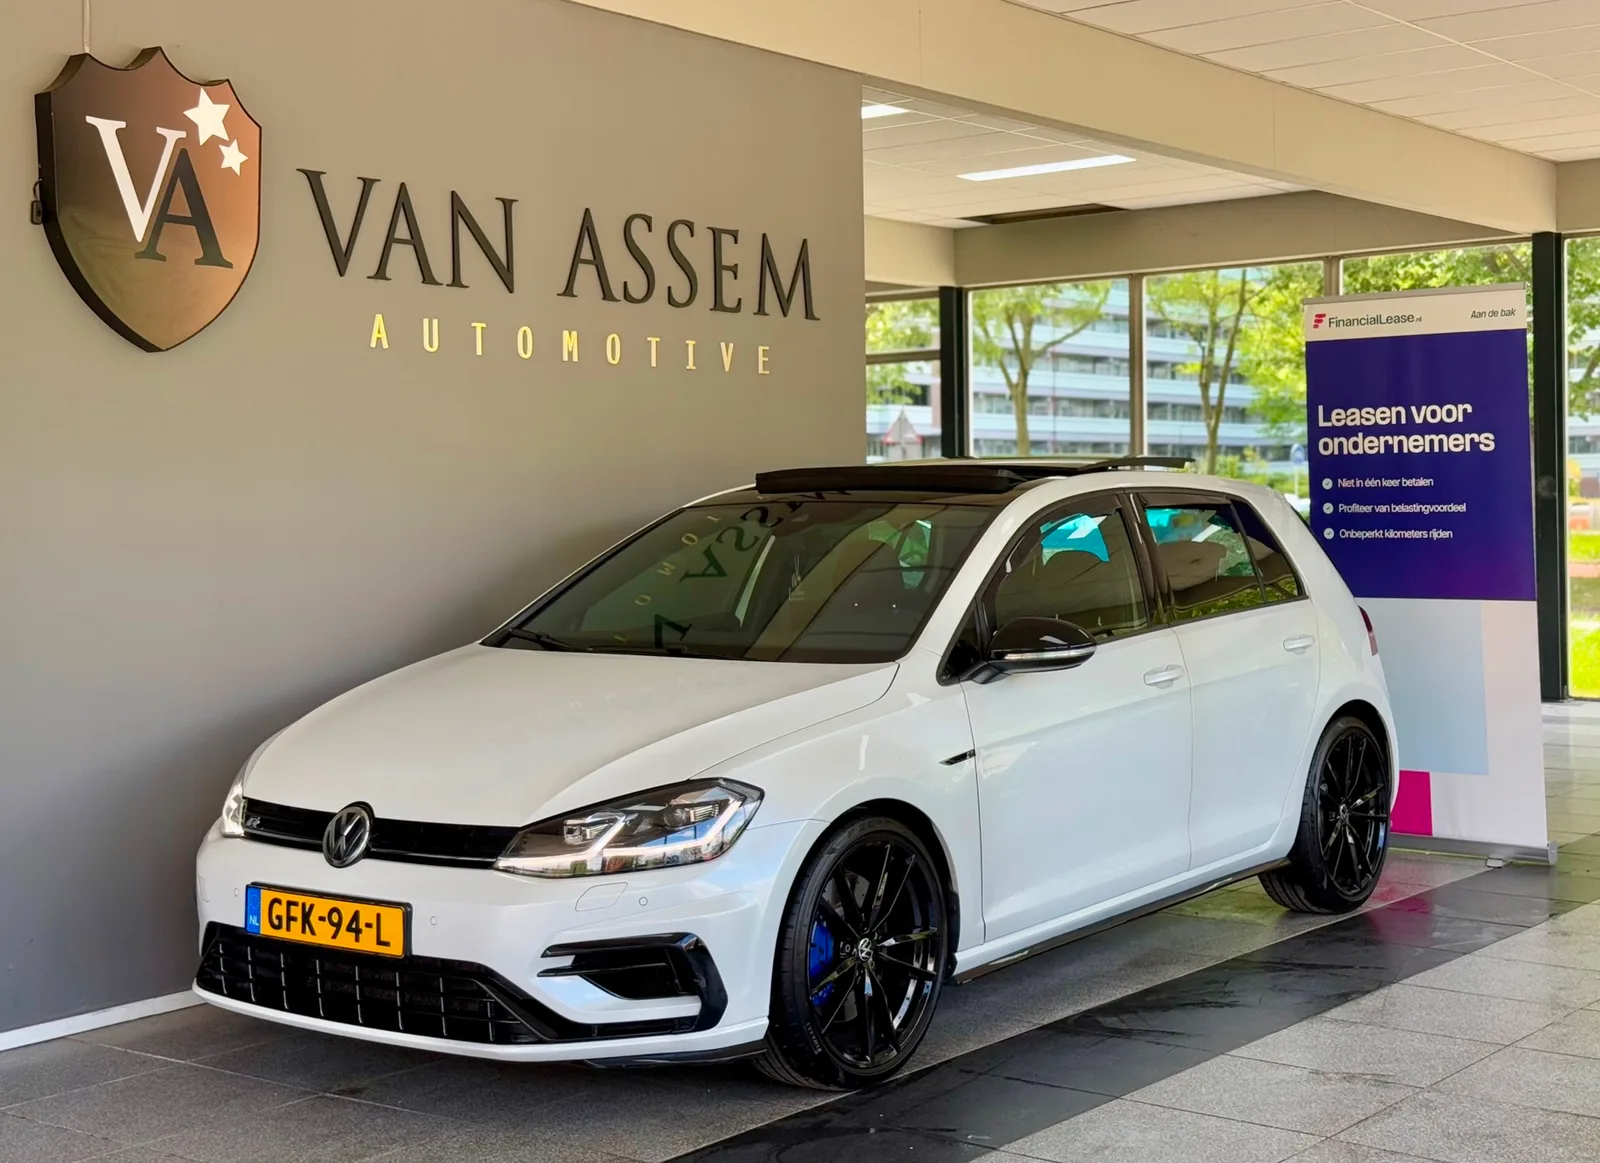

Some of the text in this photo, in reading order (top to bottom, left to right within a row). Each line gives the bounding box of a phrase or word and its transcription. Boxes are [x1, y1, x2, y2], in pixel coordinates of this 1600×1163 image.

[296, 168, 821, 321] VAN ASSEM
[1470, 308, 1516, 319] Aan de bak
[369, 313, 773, 376] AUTOMOTIVE
[1318, 403, 1472, 427] Leasen voor
[1318, 432, 1496, 456] ondernemers
[1337, 476, 1434, 488] Niet in één keer betalen
[1338, 502, 1467, 515] Profiteer van belastingvoordeel
[1339, 528, 1453, 541] Onbeperkt kilometers rijden
[249, 915, 260, 926] NL
[268, 897, 391, 948] GFK-94-L
